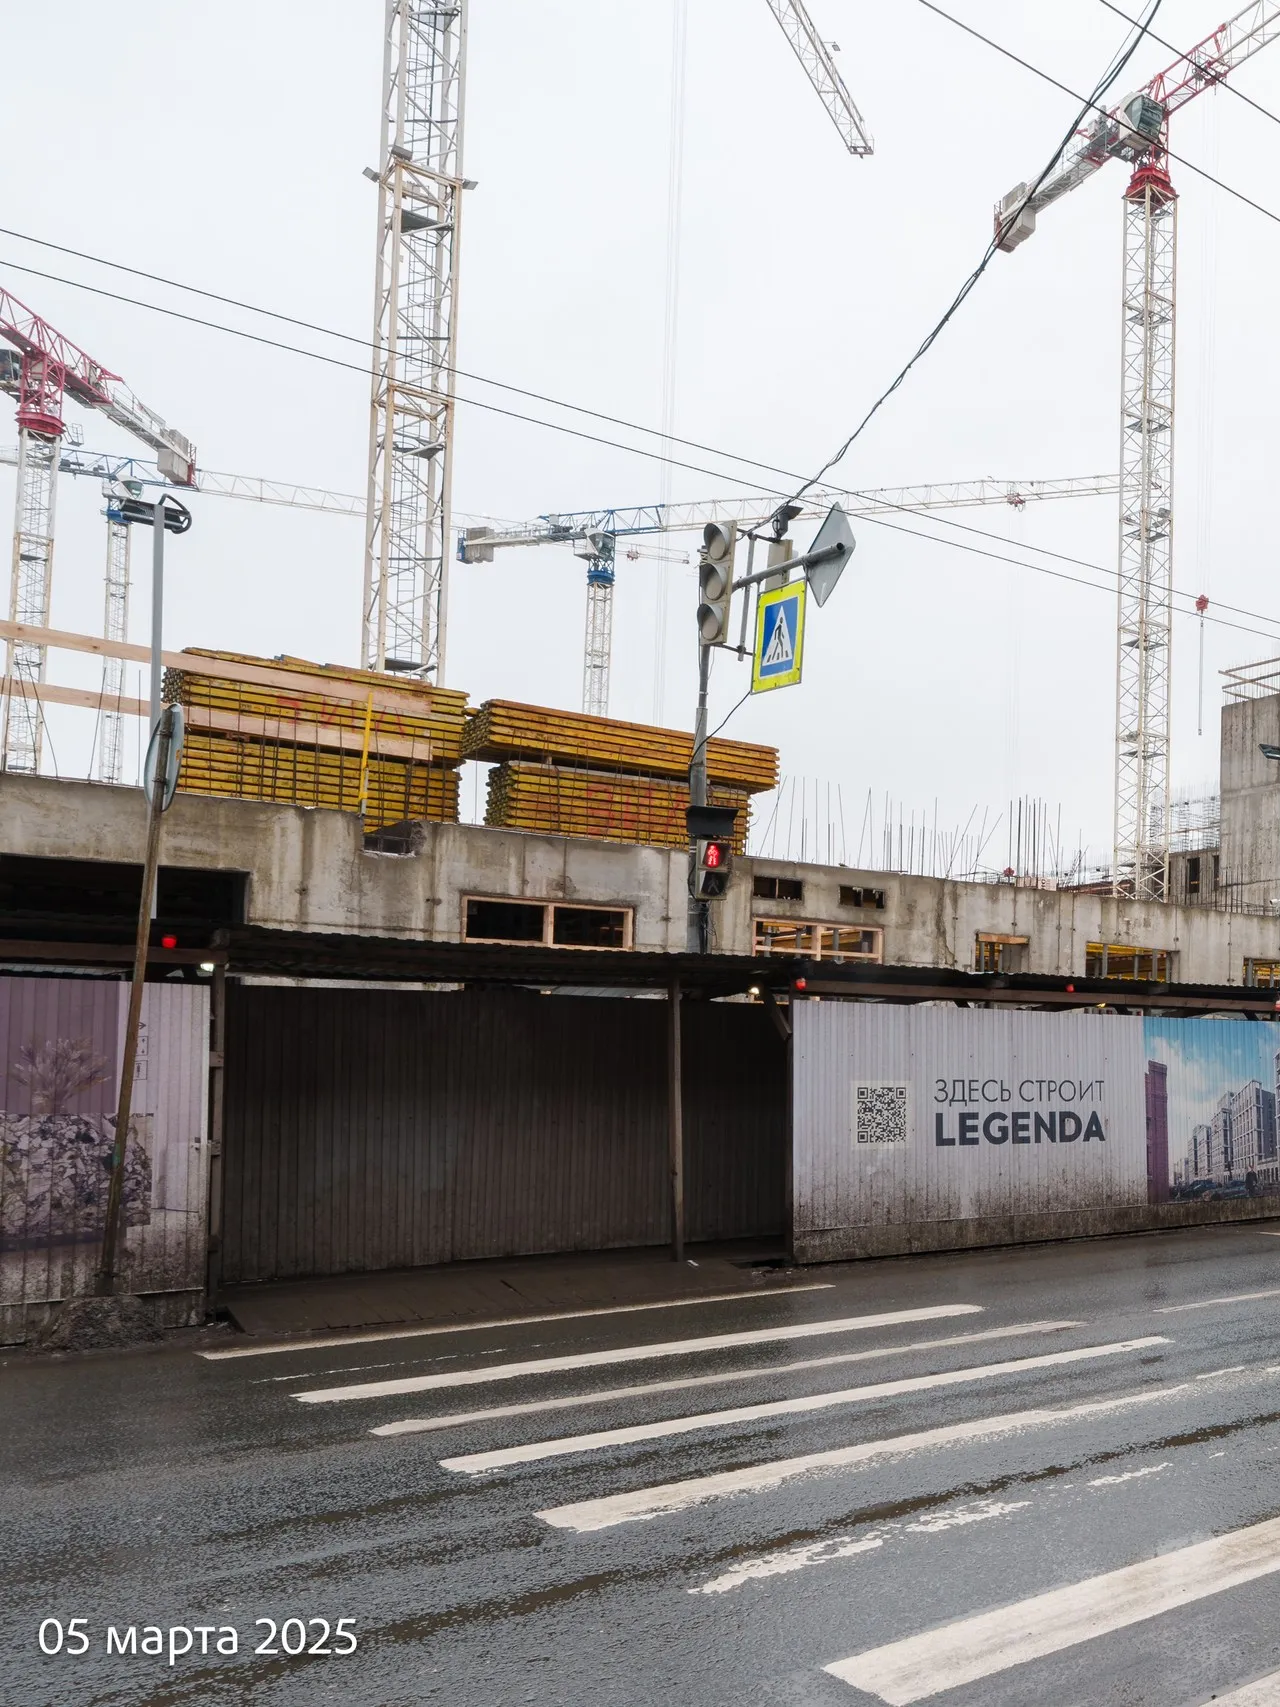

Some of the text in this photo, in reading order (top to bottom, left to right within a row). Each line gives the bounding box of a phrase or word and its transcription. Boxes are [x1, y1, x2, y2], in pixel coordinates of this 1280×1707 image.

[934, 1079, 1105, 1107] ЗДЕСЬ СТРОИТ
[935, 1110, 1106, 1147] LEGENDA
